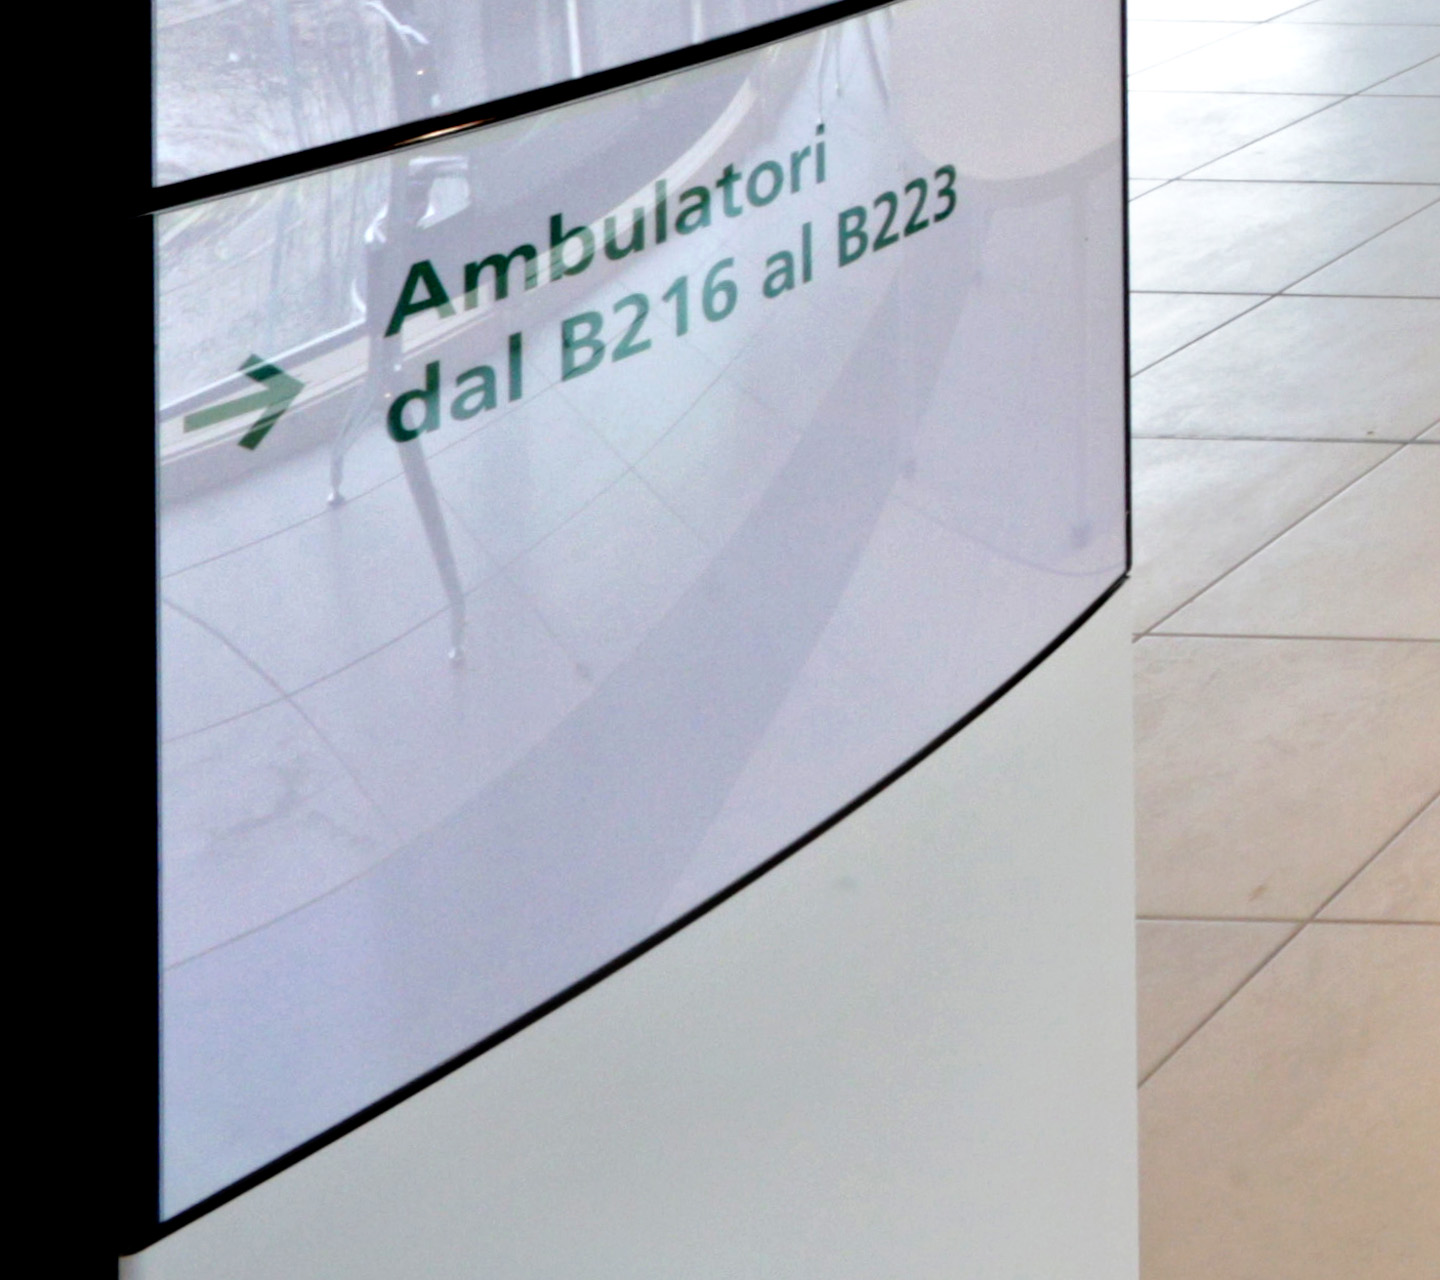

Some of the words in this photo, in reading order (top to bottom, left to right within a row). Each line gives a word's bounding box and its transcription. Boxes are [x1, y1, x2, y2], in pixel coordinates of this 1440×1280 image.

[383, 124, 828, 338] Ambulatori
[385, 334, 523, 444] dal
[560, 256, 739, 382] B216
[763, 221, 813, 300] al
[836, 163, 958, 269] B223
